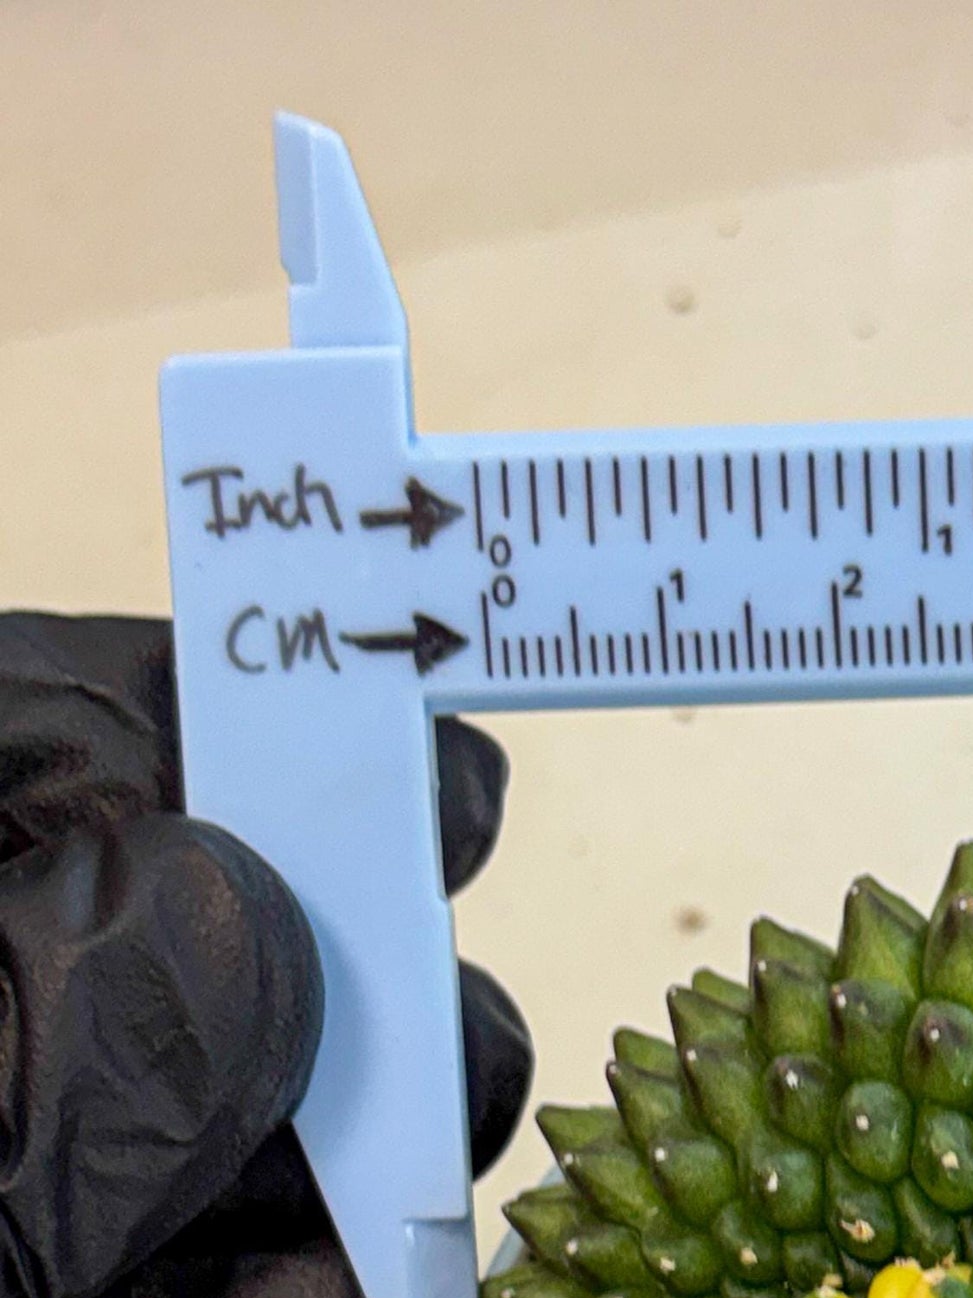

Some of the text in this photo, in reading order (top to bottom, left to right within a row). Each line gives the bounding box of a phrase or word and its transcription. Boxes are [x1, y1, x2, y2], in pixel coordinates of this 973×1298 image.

[180, 462, 344, 541] Inch
[489, 534, 513, 569] 0
[937, 523, 954, 556] 1
[491, 573, 517, 608] 0
[668, 567, 686, 604] 1
[841, 563, 864, 599] 2
